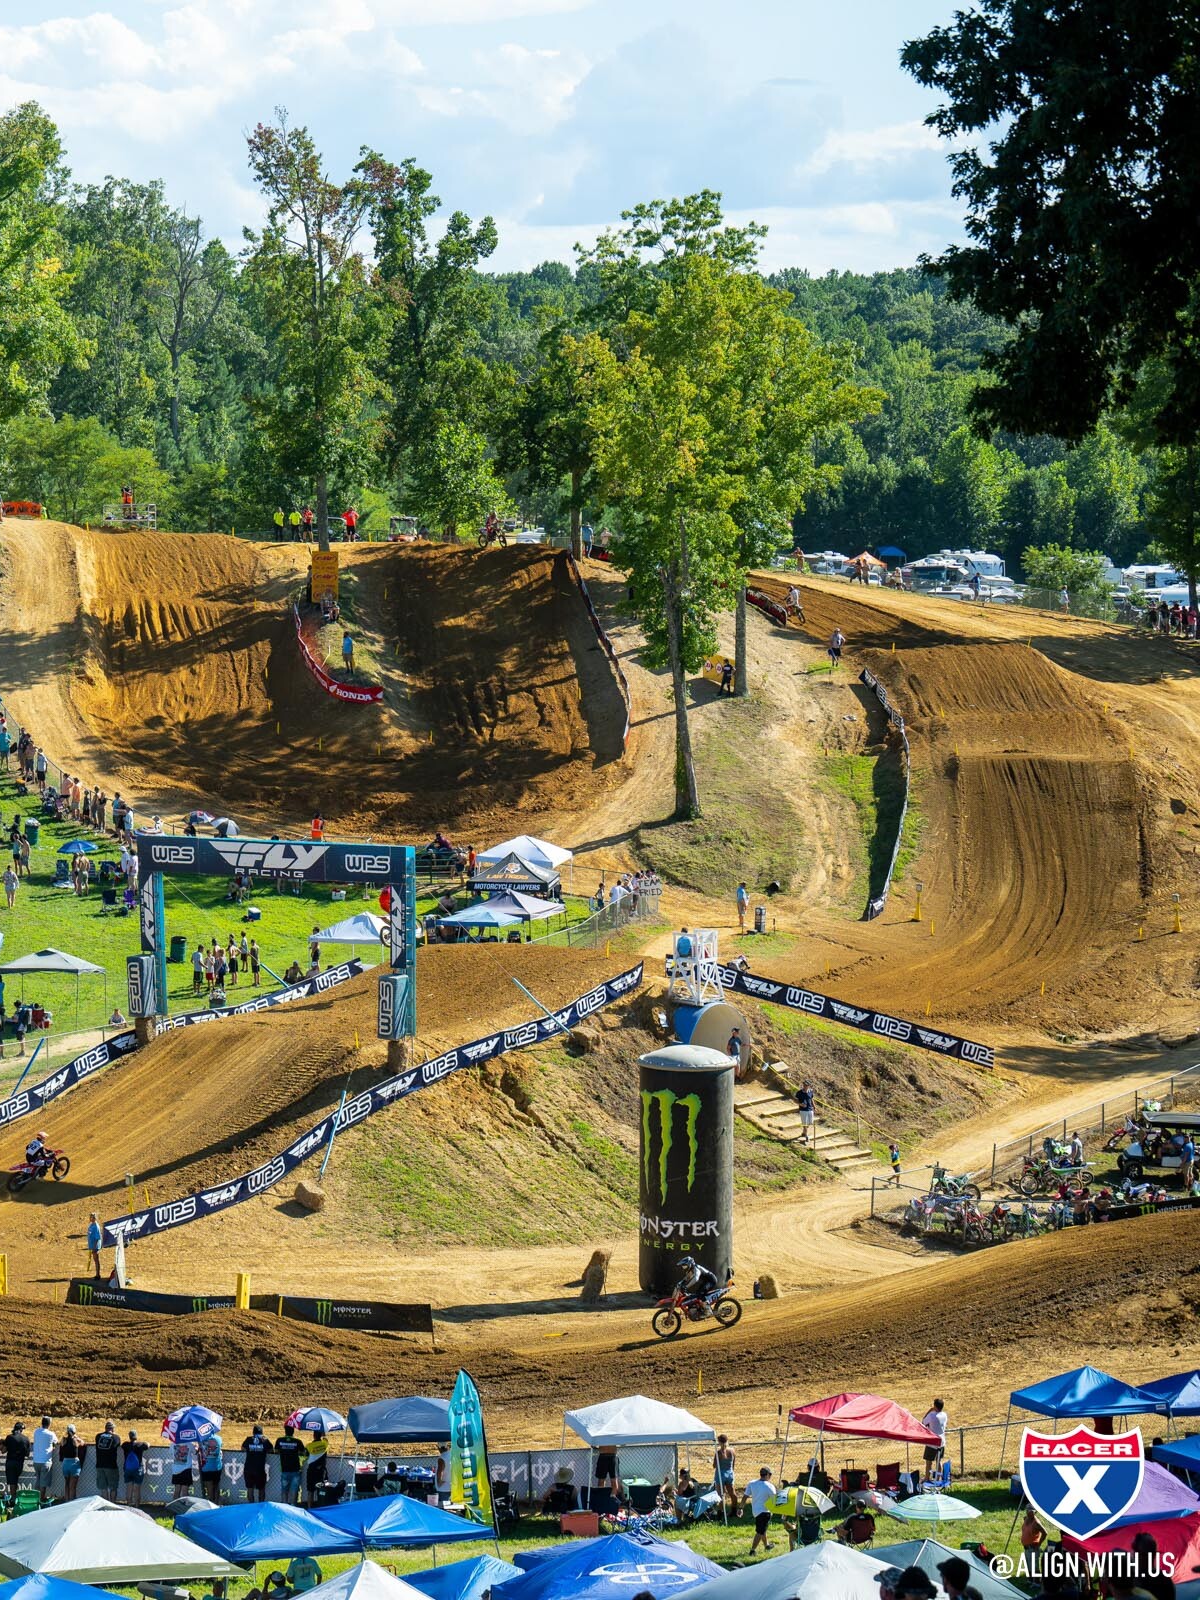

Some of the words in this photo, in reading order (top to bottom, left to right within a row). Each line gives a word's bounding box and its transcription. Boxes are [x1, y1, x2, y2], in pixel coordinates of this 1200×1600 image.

[336, 688, 371, 701] HONDA
[152, 845, 195, 864] WPS
[208, 840, 330, 870] FLY
[345, 854, 391, 874] WPS
[234, 867, 305, 878] RACING
[128, 962, 142, 1014] WPS
[316, 964, 350, 993] WPS
[379, 981, 393, 1035] WPS
[742, 976, 782, 994] FLY
[786, 987, 825, 1014] WPS
[830, 1001, 870, 1021] FLY
[873, 1014, 913, 1040] WPS
[917, 1029, 958, 1048] FLY
[33, 1068, 70, 1098] FLY
[74, 1044, 109, 1077] WPS
[105, 1214, 150, 1235] FLY
[155, 1196, 196, 1227] WPS
[201, 1182, 243, 1204] FLY
[248, 1156, 285, 1192] WPS
[288, 1123, 327, 1156] FLY
[332, 1093, 372, 1130] WPS
[376, 1072, 417, 1097] FLY
[422, 1051, 458, 1083] WPS
[462, 1037, 500, 1057] FLY
[504, 1023, 538, 1049] WPS
[576, 985, 606, 1017] WPS
[641, 1213, 720, 1238] ONSTER
[643, 1239, 704, 1251] NERGY
[93, 1291, 126, 1302] MONSTER
[333, 1306, 372, 1314] MONSTER
